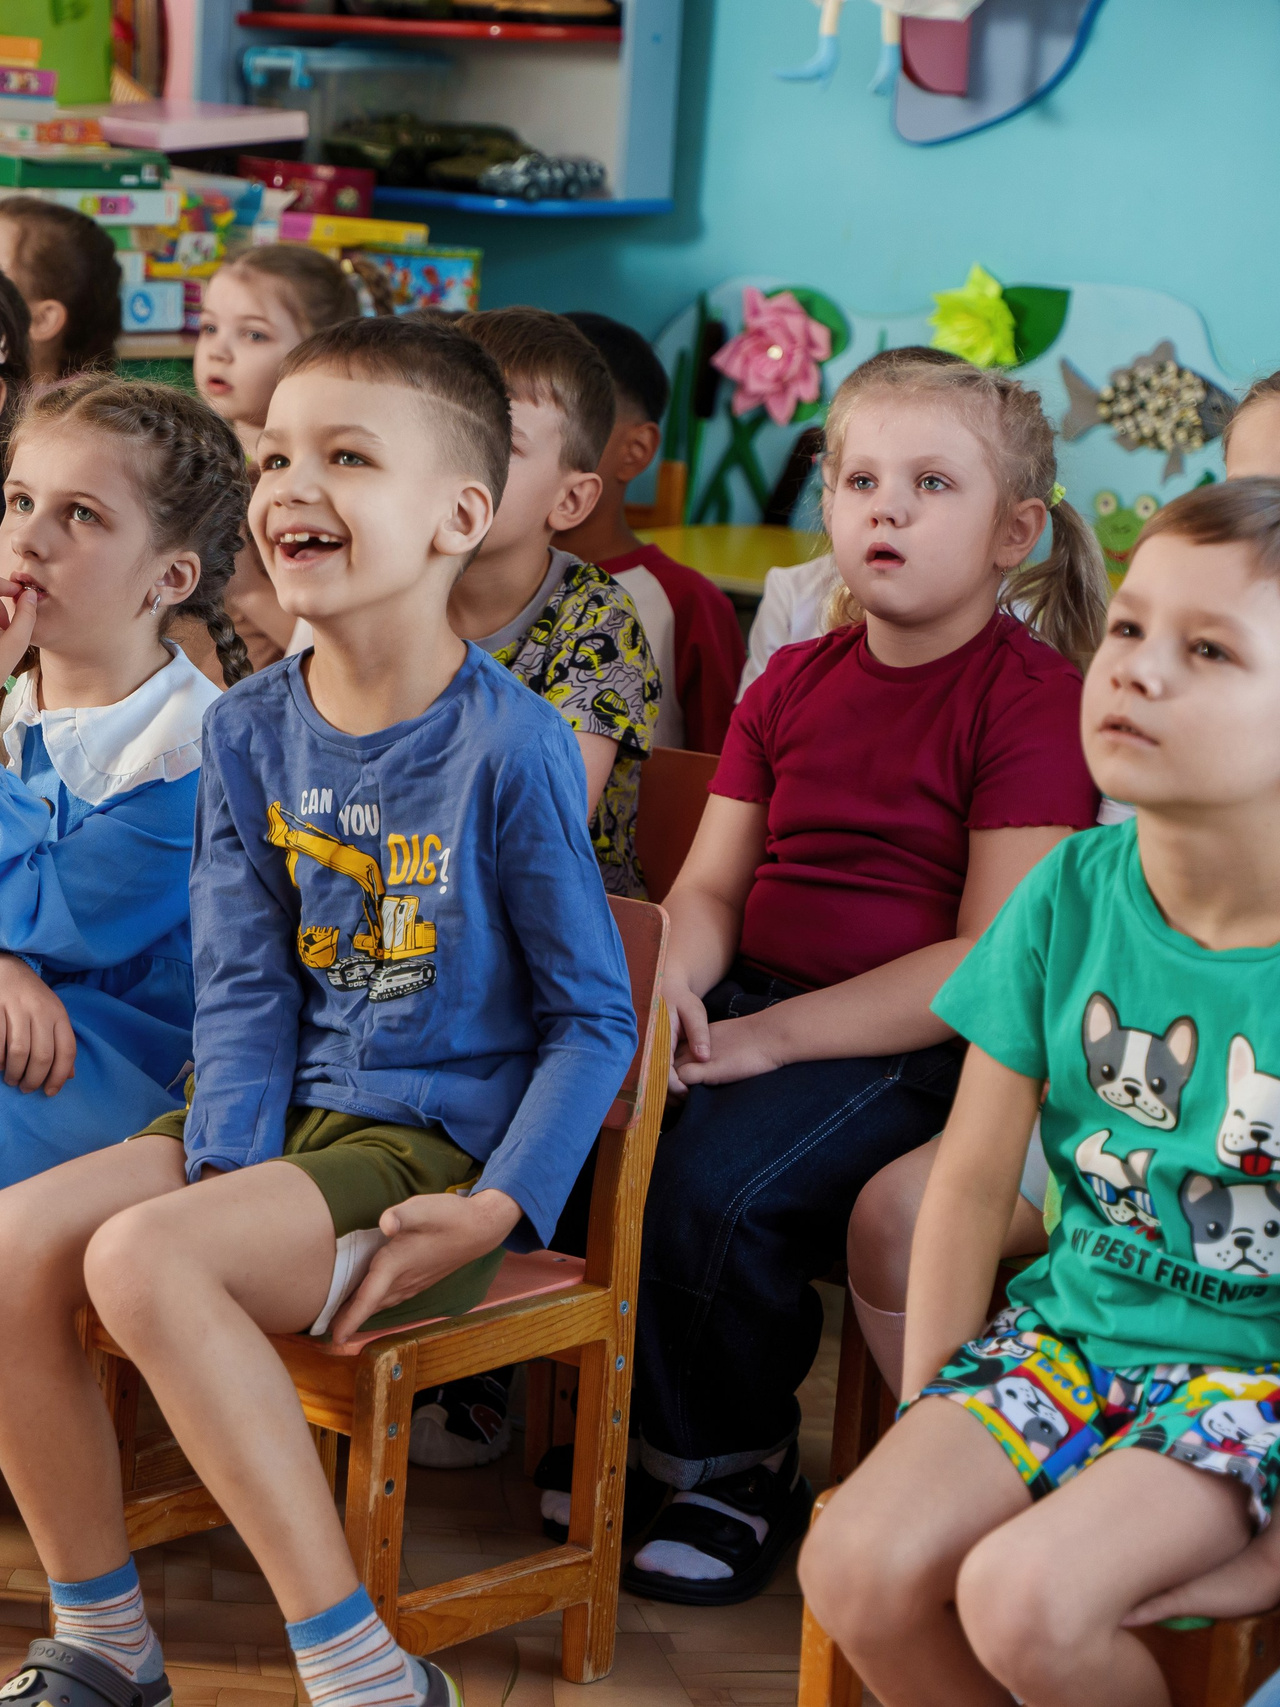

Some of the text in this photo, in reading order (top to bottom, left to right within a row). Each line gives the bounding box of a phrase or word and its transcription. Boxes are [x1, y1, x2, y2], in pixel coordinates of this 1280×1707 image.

[301, 787, 333, 816] CAN
[339, 803, 380, 836] YOU
[387, 832, 451, 895] DIG?
[1072, 1228, 1094, 1255] MY
[1091, 1233, 1153, 1276] BEST
